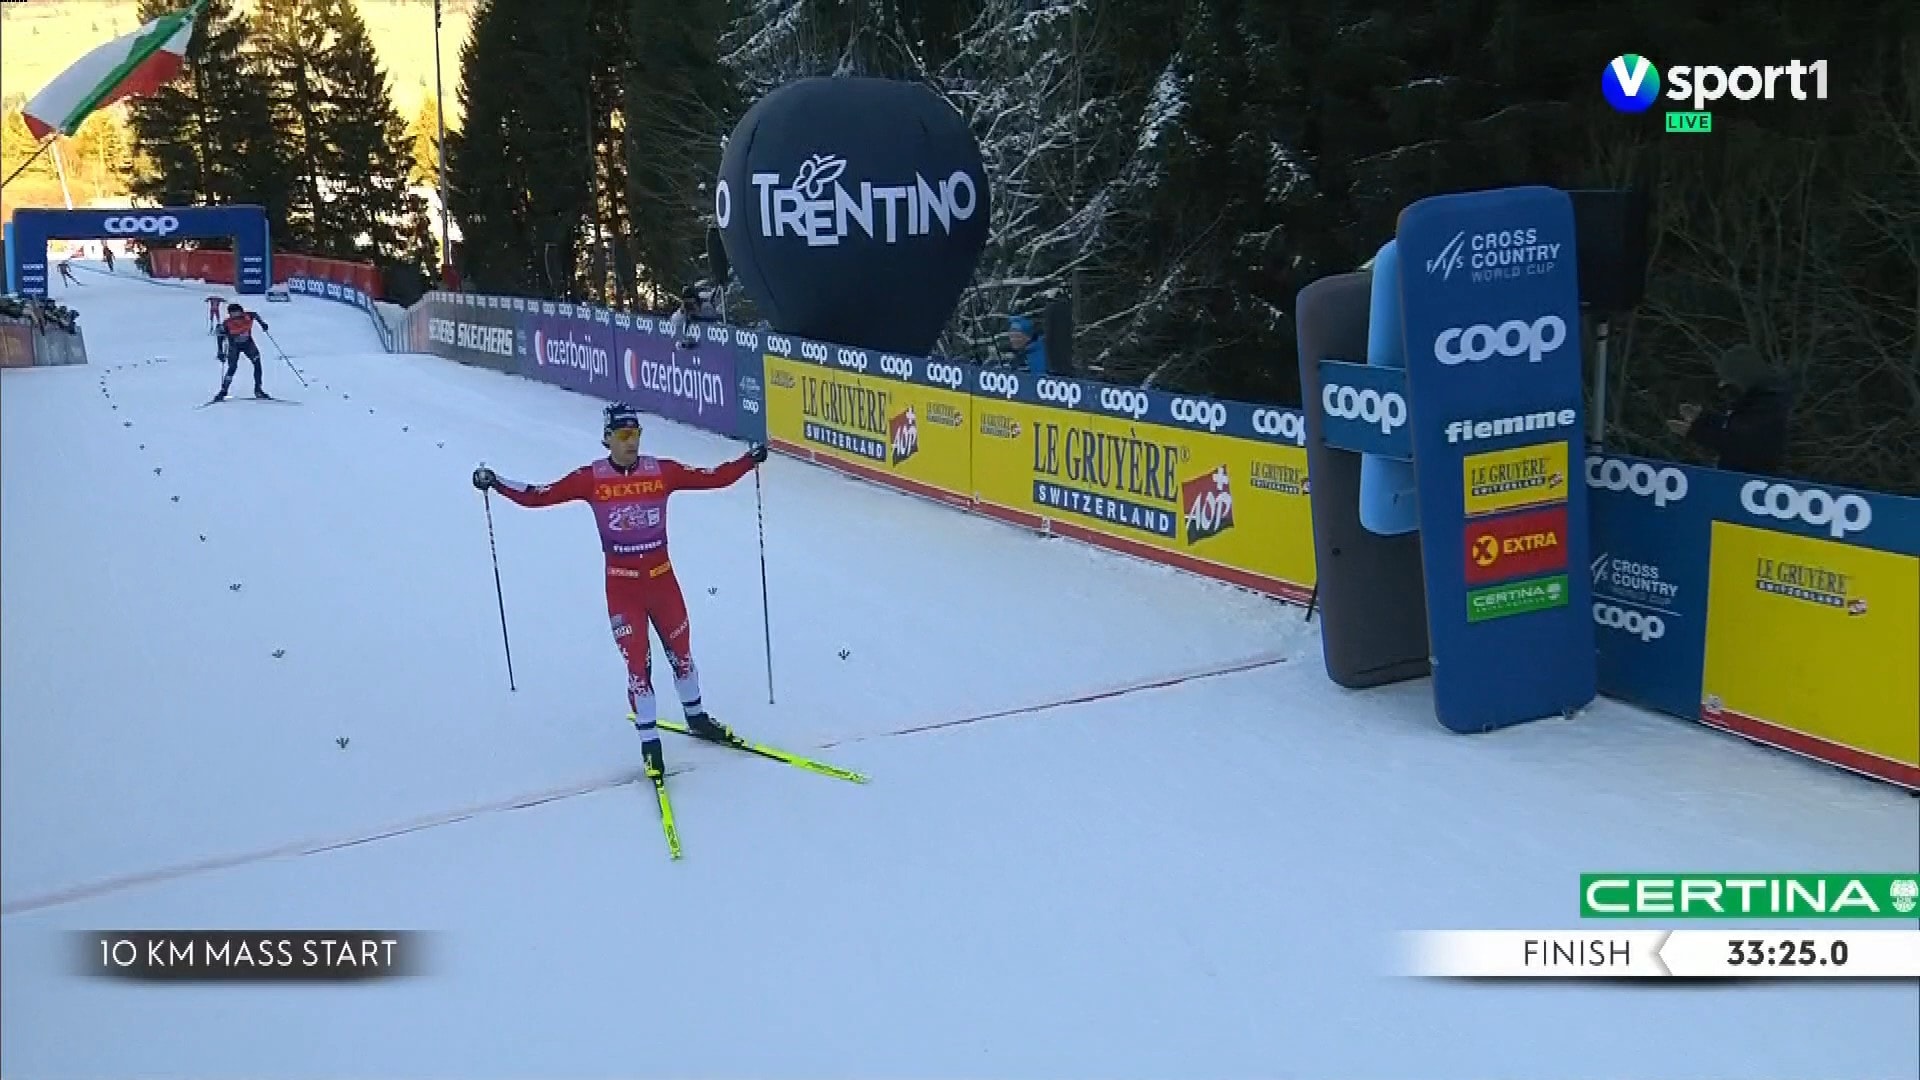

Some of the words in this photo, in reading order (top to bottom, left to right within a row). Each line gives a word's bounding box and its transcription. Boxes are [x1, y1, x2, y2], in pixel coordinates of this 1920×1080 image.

[752, 170, 976, 246] TRENTINO
[103, 215, 179, 236] coop
[1471, 228, 1537, 251] CROSS
[1471, 243, 1560, 269] COUNTRY
[1471, 265, 1520, 282] WORLD
[1527, 262, 1555, 275] CUP
[457, 323, 512, 356] SKECHERS
[1434, 315, 1567, 365] coop
[547, 330, 608, 384] azerbaijan
[595, 308, 610, 326] coop
[615, 311, 630, 330] coop
[636, 317, 653, 335] coop
[659, 319, 676, 338] coop
[707, 326, 728, 346] coop
[736, 329, 758, 352] coop
[767, 335, 791, 358] coop
[801, 341, 828, 364] coop
[837, 347, 868, 372] coop
[880, 354, 913, 380] coop
[926, 362, 962, 392] coop
[979, 371, 1019, 399] coop
[1036, 378, 1081, 409] coop
[1100, 387, 1149, 419] coop
[1171, 397, 1227, 432] coop
[641, 351, 724, 416] azerbaijan
[743, 398, 759, 414] coop
[801, 376, 818, 417] LE
[820, 378, 887, 435] GRUYÈRE
[1322, 383, 1407, 435] coop
[807, 424, 882, 458] SWITZERLAND
[892, 425, 917, 457] AOP
[1445, 409, 1576, 443] fiemme
[1033, 421, 1059, 475] LE
[612, 480, 663, 497] EXTRA
[1585, 456, 1688, 507] coop
[1039, 485, 1169, 533] SWITZERLAND
[1186, 491, 1233, 532] AOP
[1740, 479, 1872, 538] coop
[1503, 531, 1557, 555] EXTRA
[1612, 559, 1659, 579] CROSS
[1612, 573, 1679, 597] COUNTRY
[1757, 557, 1774, 580] LE
[1473, 586, 1545, 607] CERTINA
[1593, 603, 1665, 642] coop
